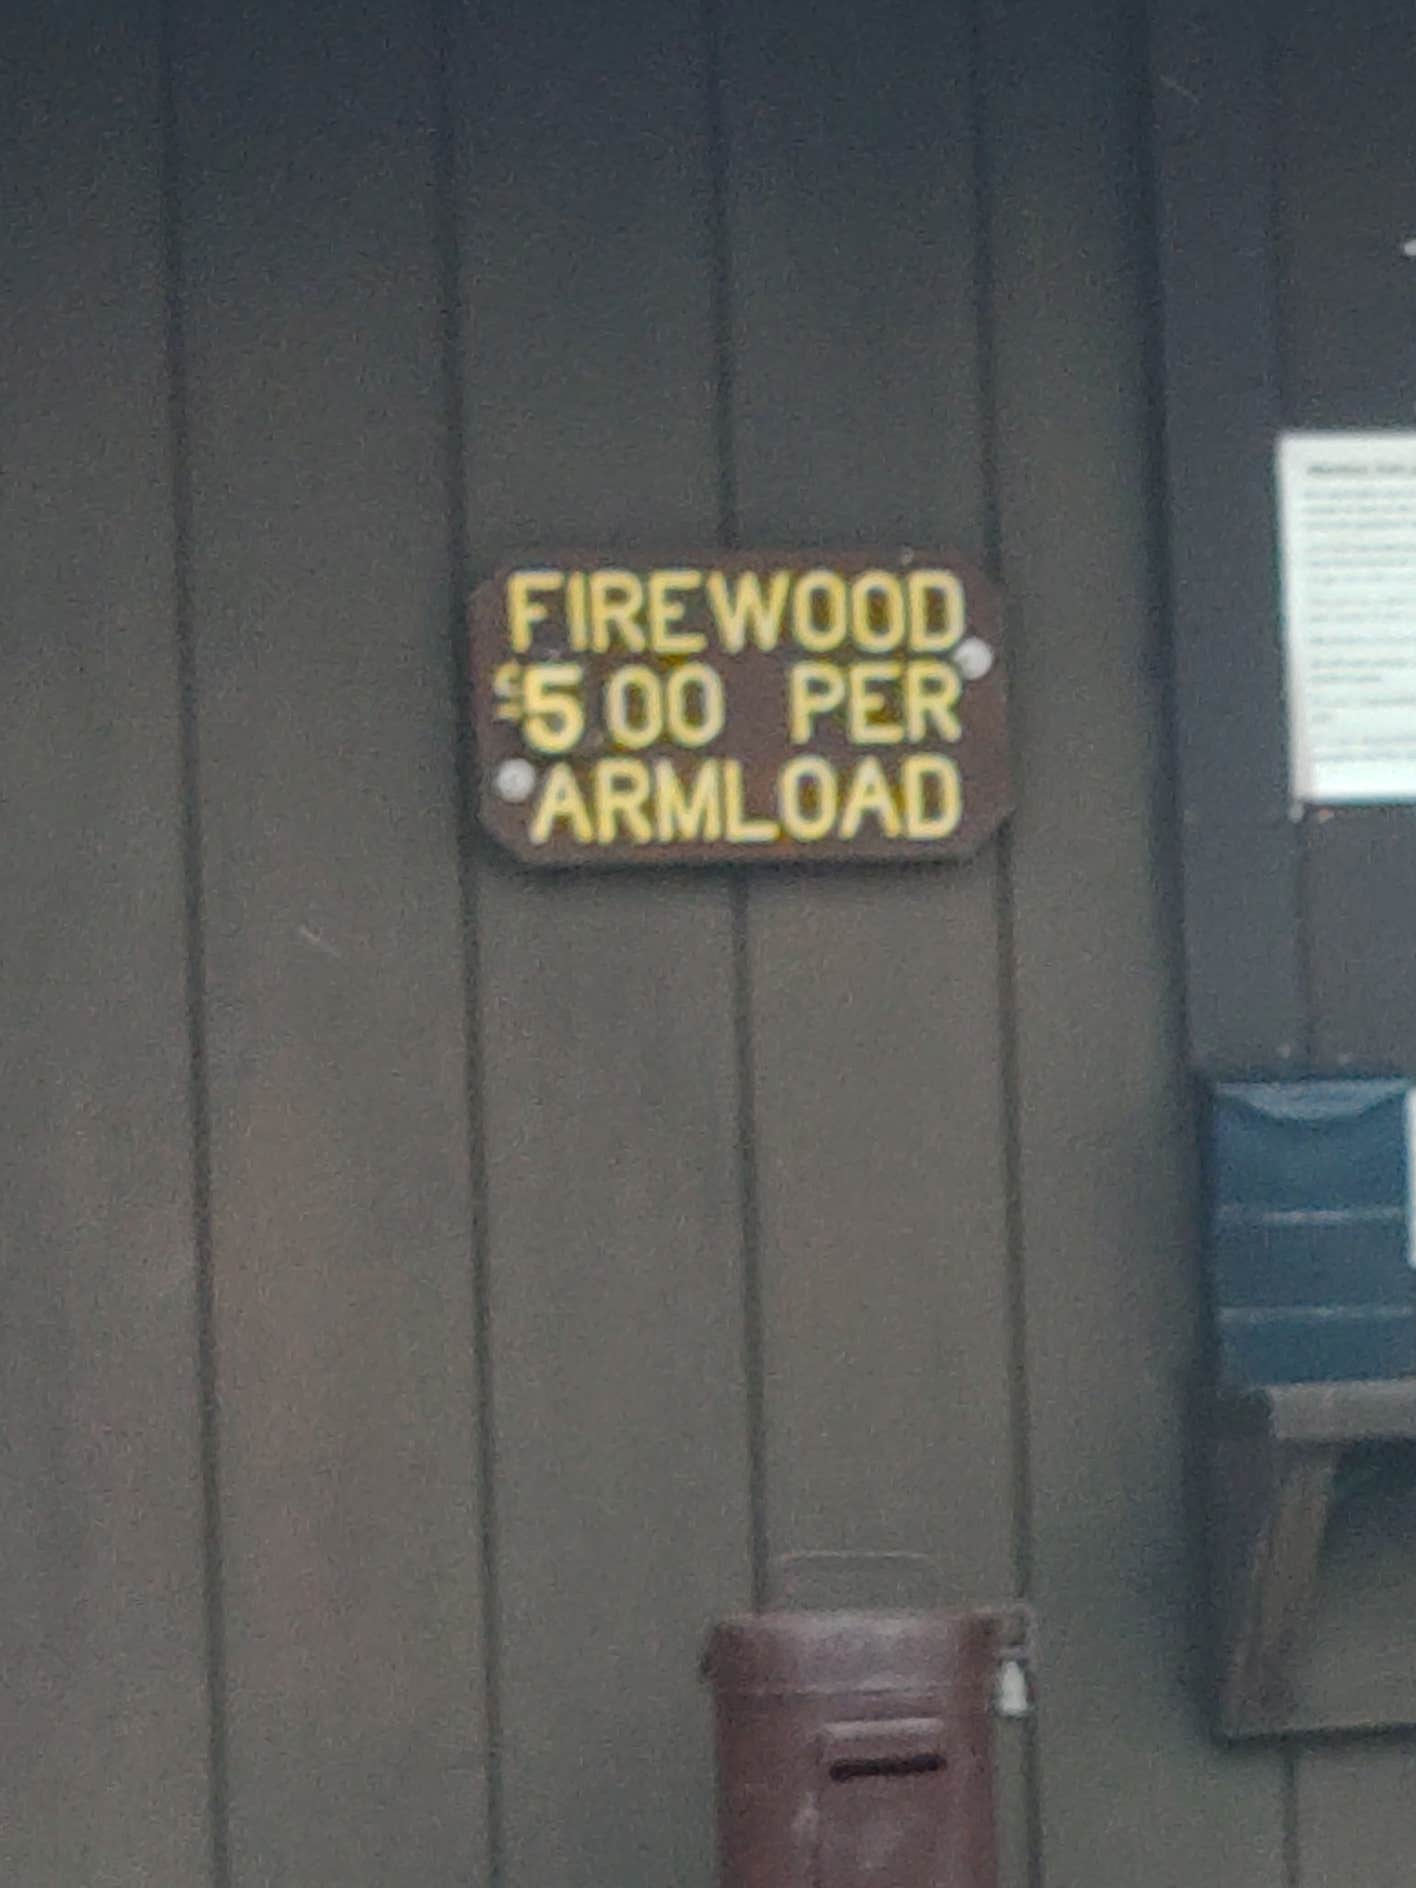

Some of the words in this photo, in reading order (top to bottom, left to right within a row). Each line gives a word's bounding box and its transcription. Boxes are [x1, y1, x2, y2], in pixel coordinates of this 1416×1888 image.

[506, 568, 966, 655] FIREWOOD
[788, 661, 963, 745] PER
[529, 754, 964, 845] ARMLOAD
